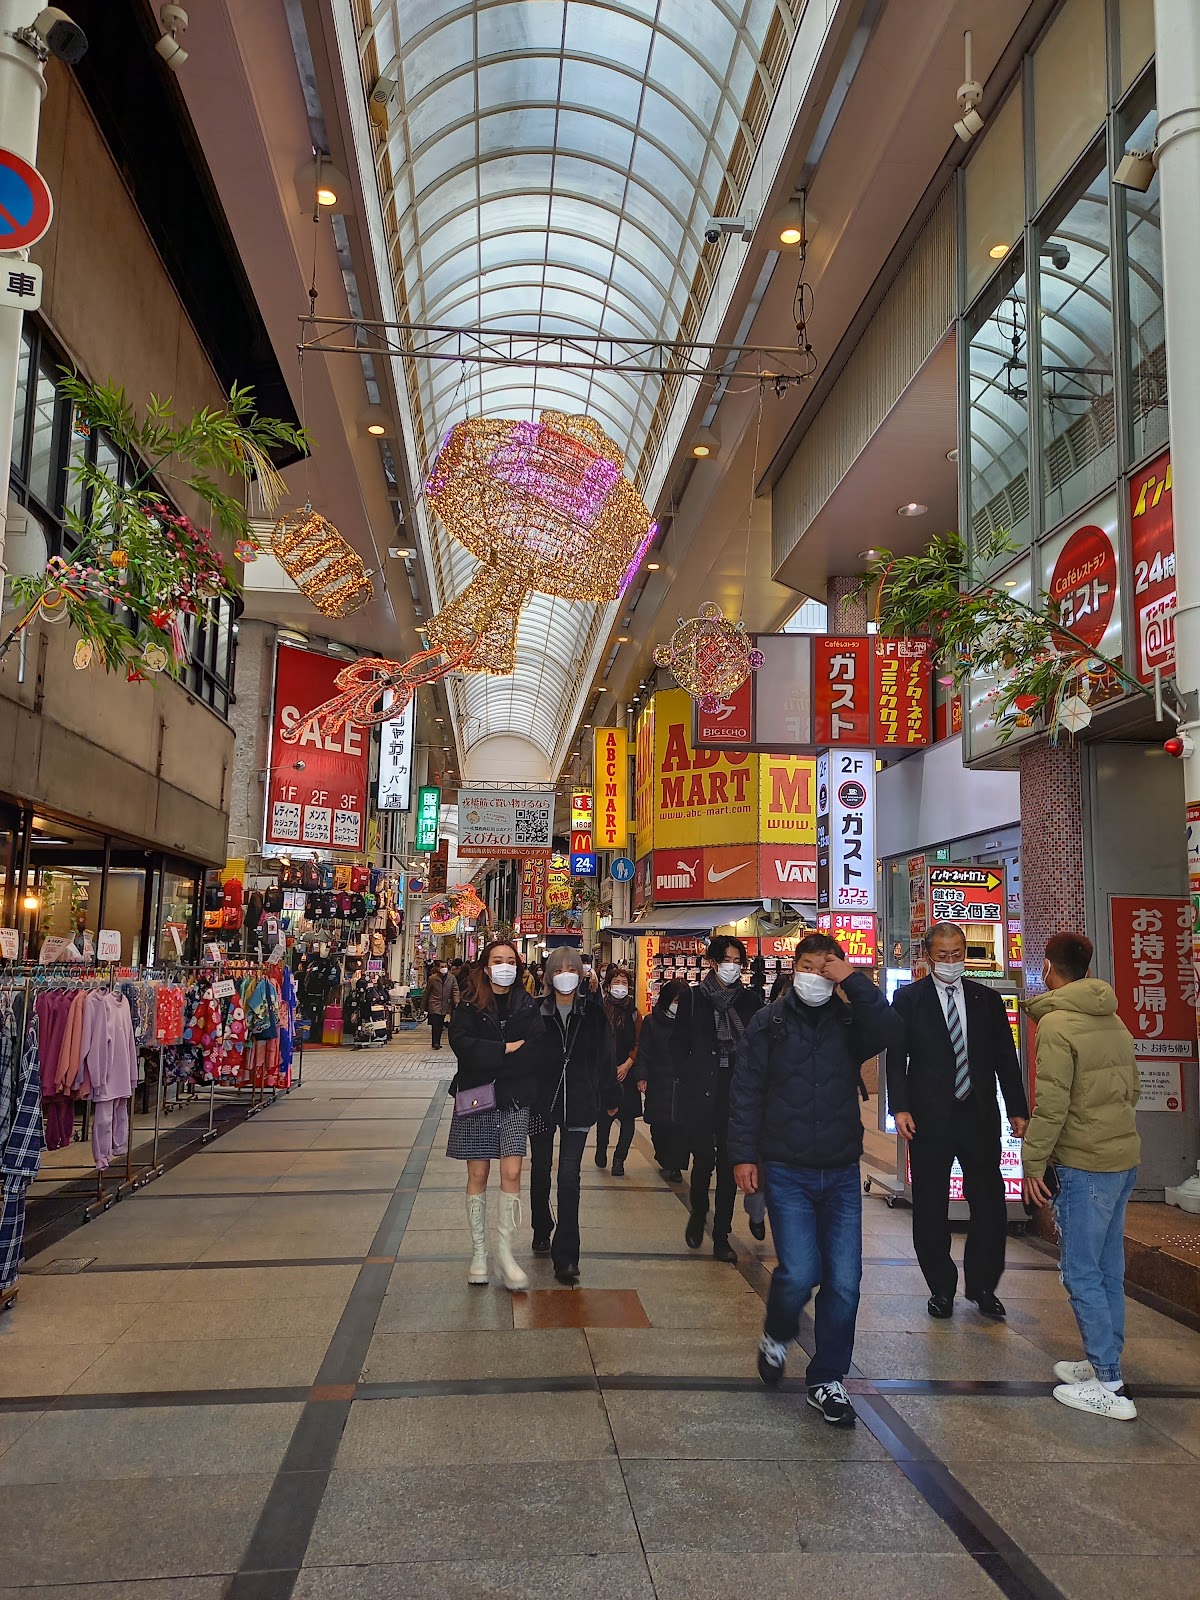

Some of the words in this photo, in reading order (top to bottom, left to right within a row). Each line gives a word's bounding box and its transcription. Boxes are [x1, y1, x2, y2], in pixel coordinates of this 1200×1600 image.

[7, 272, 37, 298] 車
[1058, 579, 1109, 629] ガスト
[824, 641, 860, 649] Caféレストラン
[829, 652, 856, 740] ガスト
[880, 659, 898, 744] コミックカフェ
[280, 705, 362, 757] SALE
[703, 728, 721, 738] BIG
[721, 728, 747, 738] ECHO
[841, 756, 864, 774] 2F
[280, 785, 298, 801] 1F
[661, 768, 751, 810] MART
[311, 789, 329, 805] 2F
[340, 794, 357, 809] 3F
[274, 805, 299, 818] レディース
[309, 810, 327, 820] メンズ
[335, 812, 359, 825] トラベル
[659, 805, 751, 820] www.abc-mart.com
[305, 822, 329, 831] ビジネス
[841, 812, 863, 885] ガスト
[656, 874, 692, 890] PUMA
[931, 870, 987, 882] インターネットカフェ
[838, 888, 868, 898] カフェ
[932, 889, 965, 901] 鍵付き
[933, 903, 1001, 920] 完全個室
[835, 915, 851, 928] 3F
[834, 928, 867, 942] ネット
[669, 940, 695, 951] SALE
[848, 942, 874, 955] カフェ
[368, 960, 382, 971] SALE
[1130, 908, 1167, 1039] お持ち帰り
[1150, 1043, 1190, 1054] お持ち帰り
